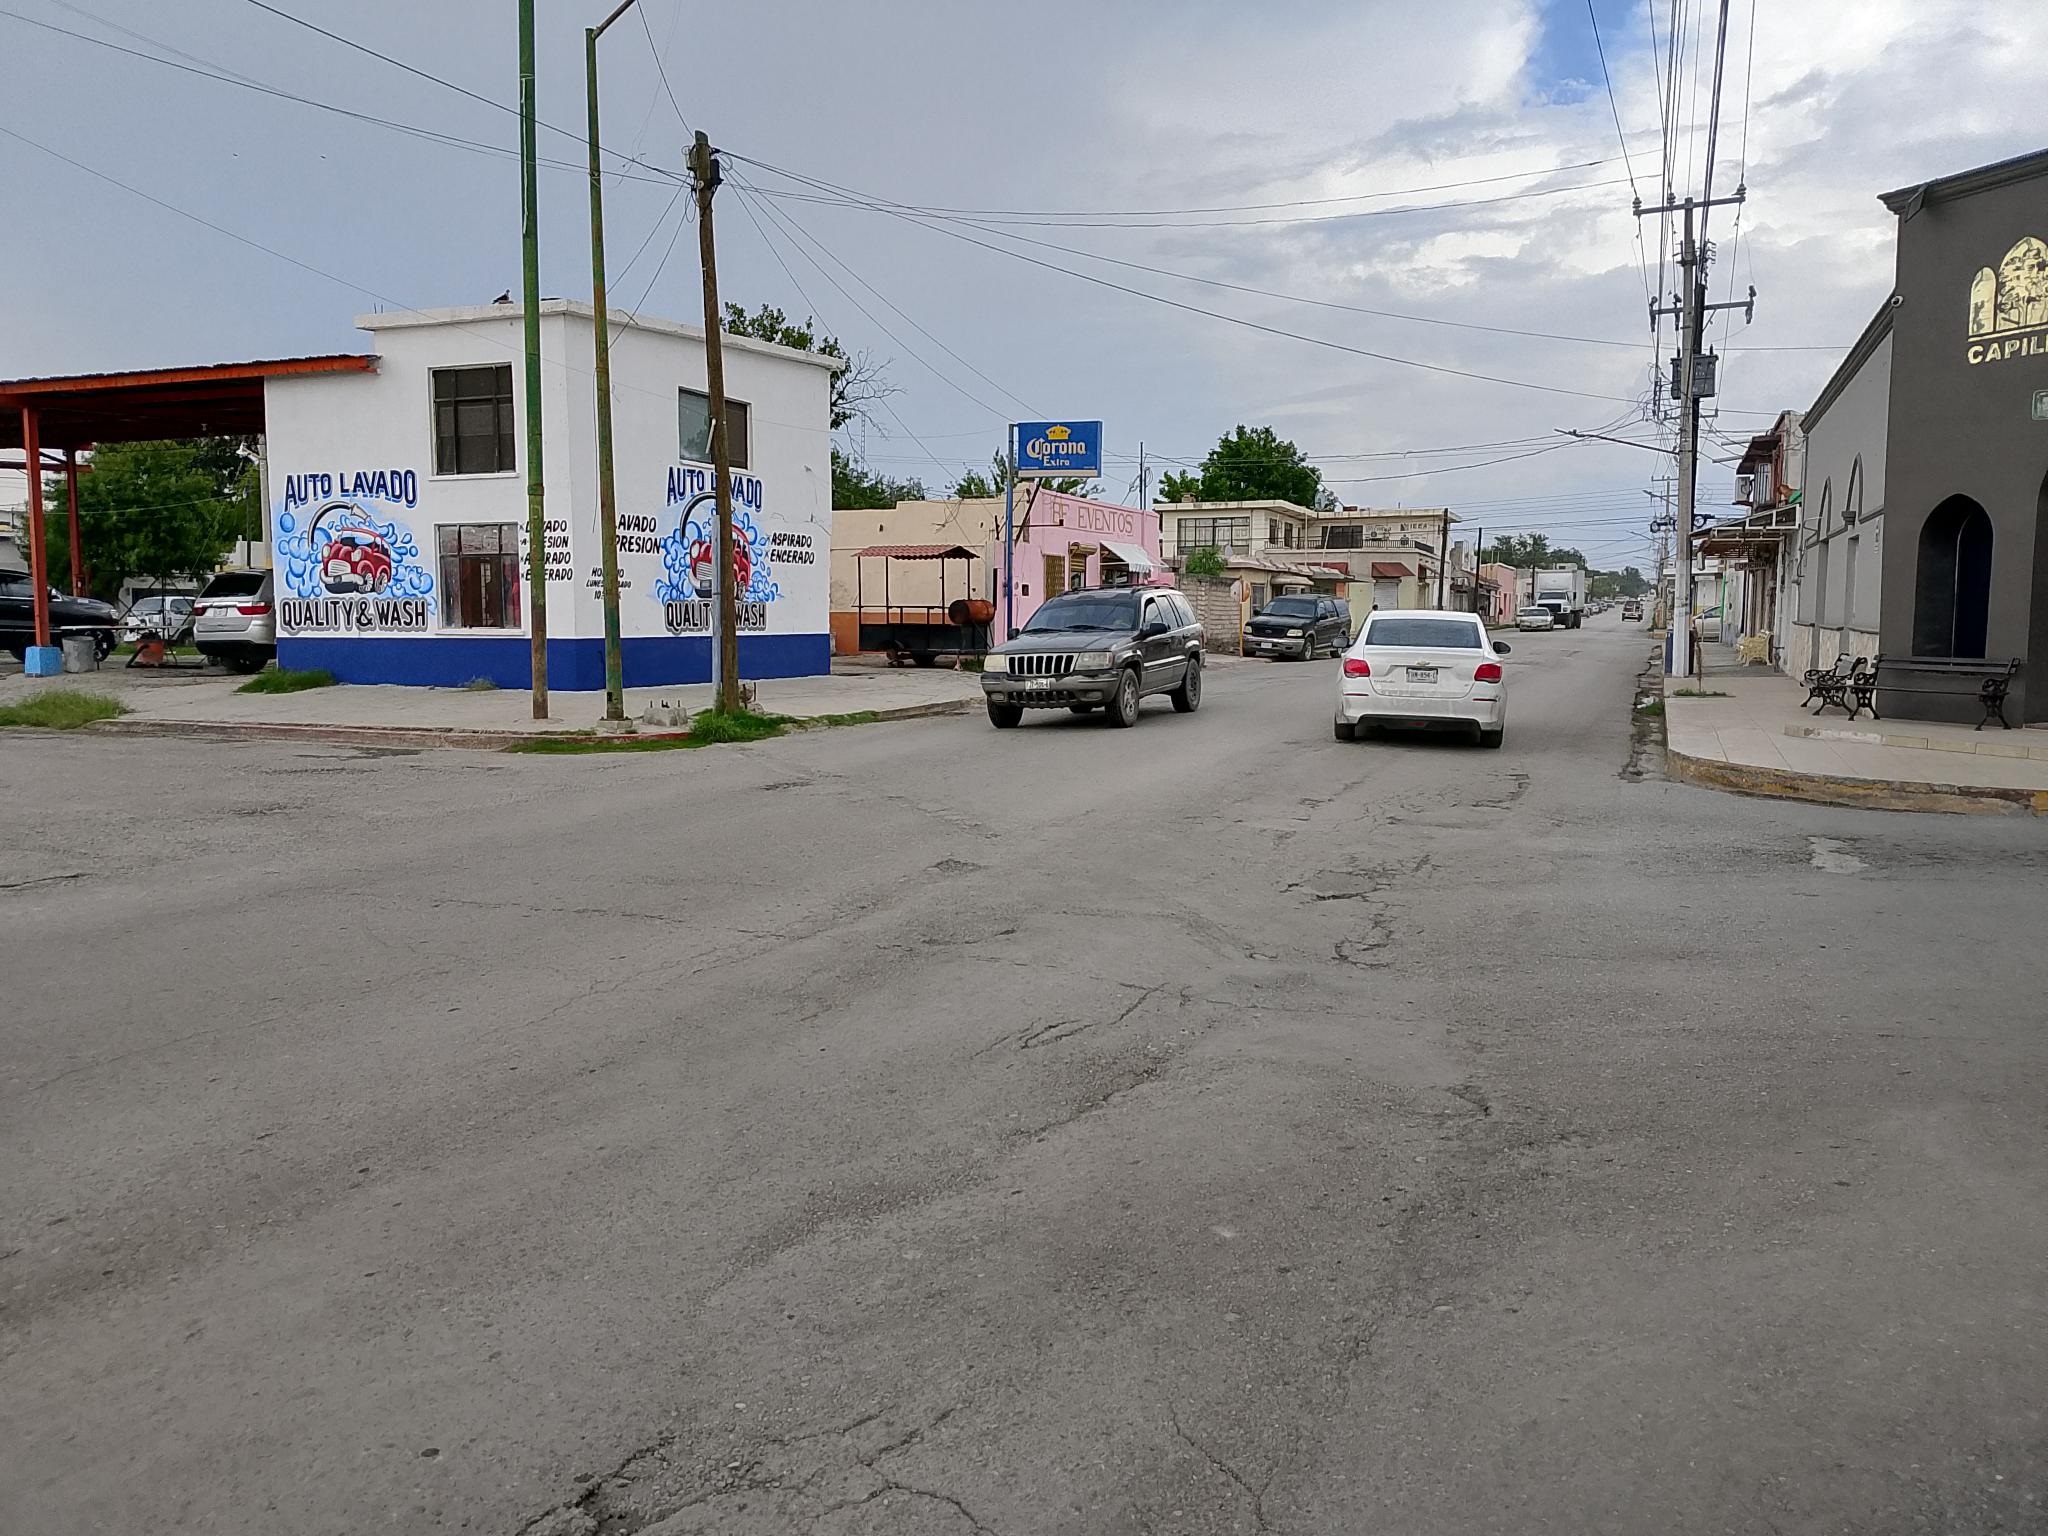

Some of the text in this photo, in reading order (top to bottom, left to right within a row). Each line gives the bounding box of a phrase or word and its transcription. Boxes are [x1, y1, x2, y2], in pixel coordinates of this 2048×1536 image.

[1967, 333, 2048, 364] CAPIL
[1027, 437, 1087, 460] Corona
[1044, 457, 1070, 466] Extra
[284, 469, 418, 512] AUTO LAVADO
[667, 467, 763, 512] AUTO LVADO
[616, 514, 657, 533] AVADO
[1078, 505, 1133, 534] EVENTOS
[770, 532, 812, 549] ASPIRADO
[770, 549, 815, 565] ENCERADO
[281, 599, 426, 630] QUALITY & WASH
[666, 602, 712, 631] QUALIT
